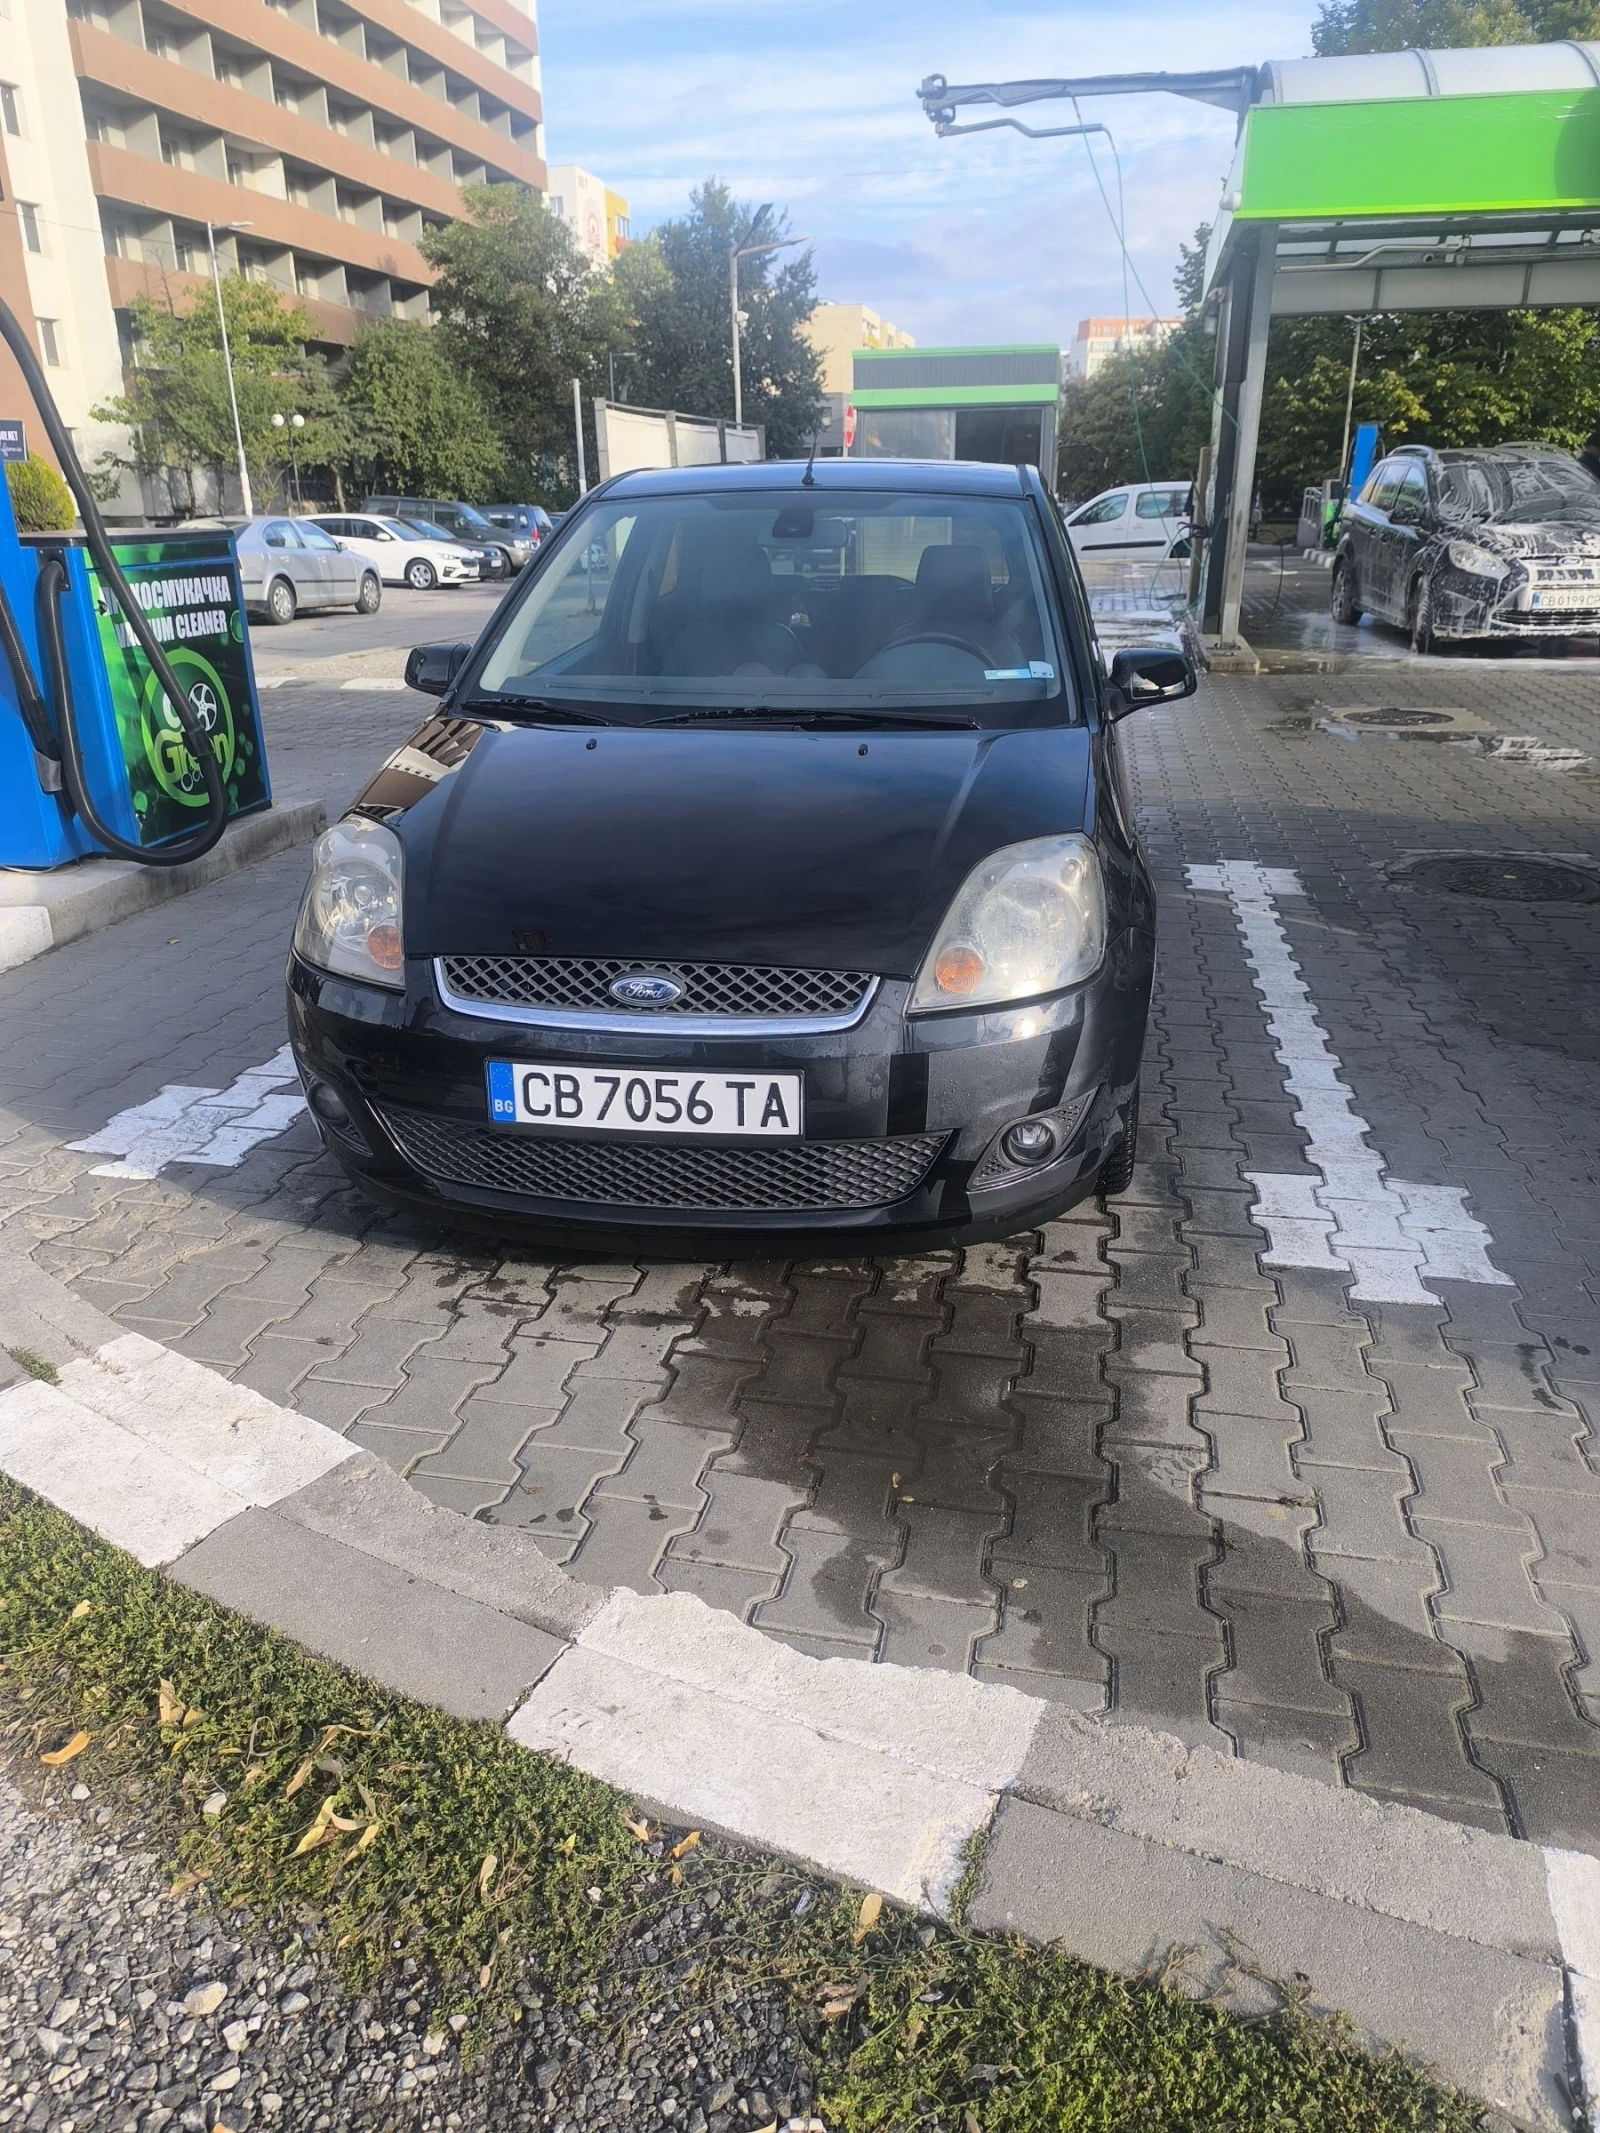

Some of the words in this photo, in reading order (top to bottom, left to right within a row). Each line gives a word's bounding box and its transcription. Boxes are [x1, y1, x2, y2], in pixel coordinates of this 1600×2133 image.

[98, 575, 231, 616] ПХОСМУКАЧКА
[114, 616, 175, 648] VAUM
[175, 609, 228, 639] CLEANER
[155, 729, 234, 784] Grn
[625, 981, 666, 999] Ford
[494, 1098, 514, 1113] BG
[522, 1071, 583, 1118] CB
[594, 1075, 714, 1125] 7056
[725, 1081, 790, 1128] TA
